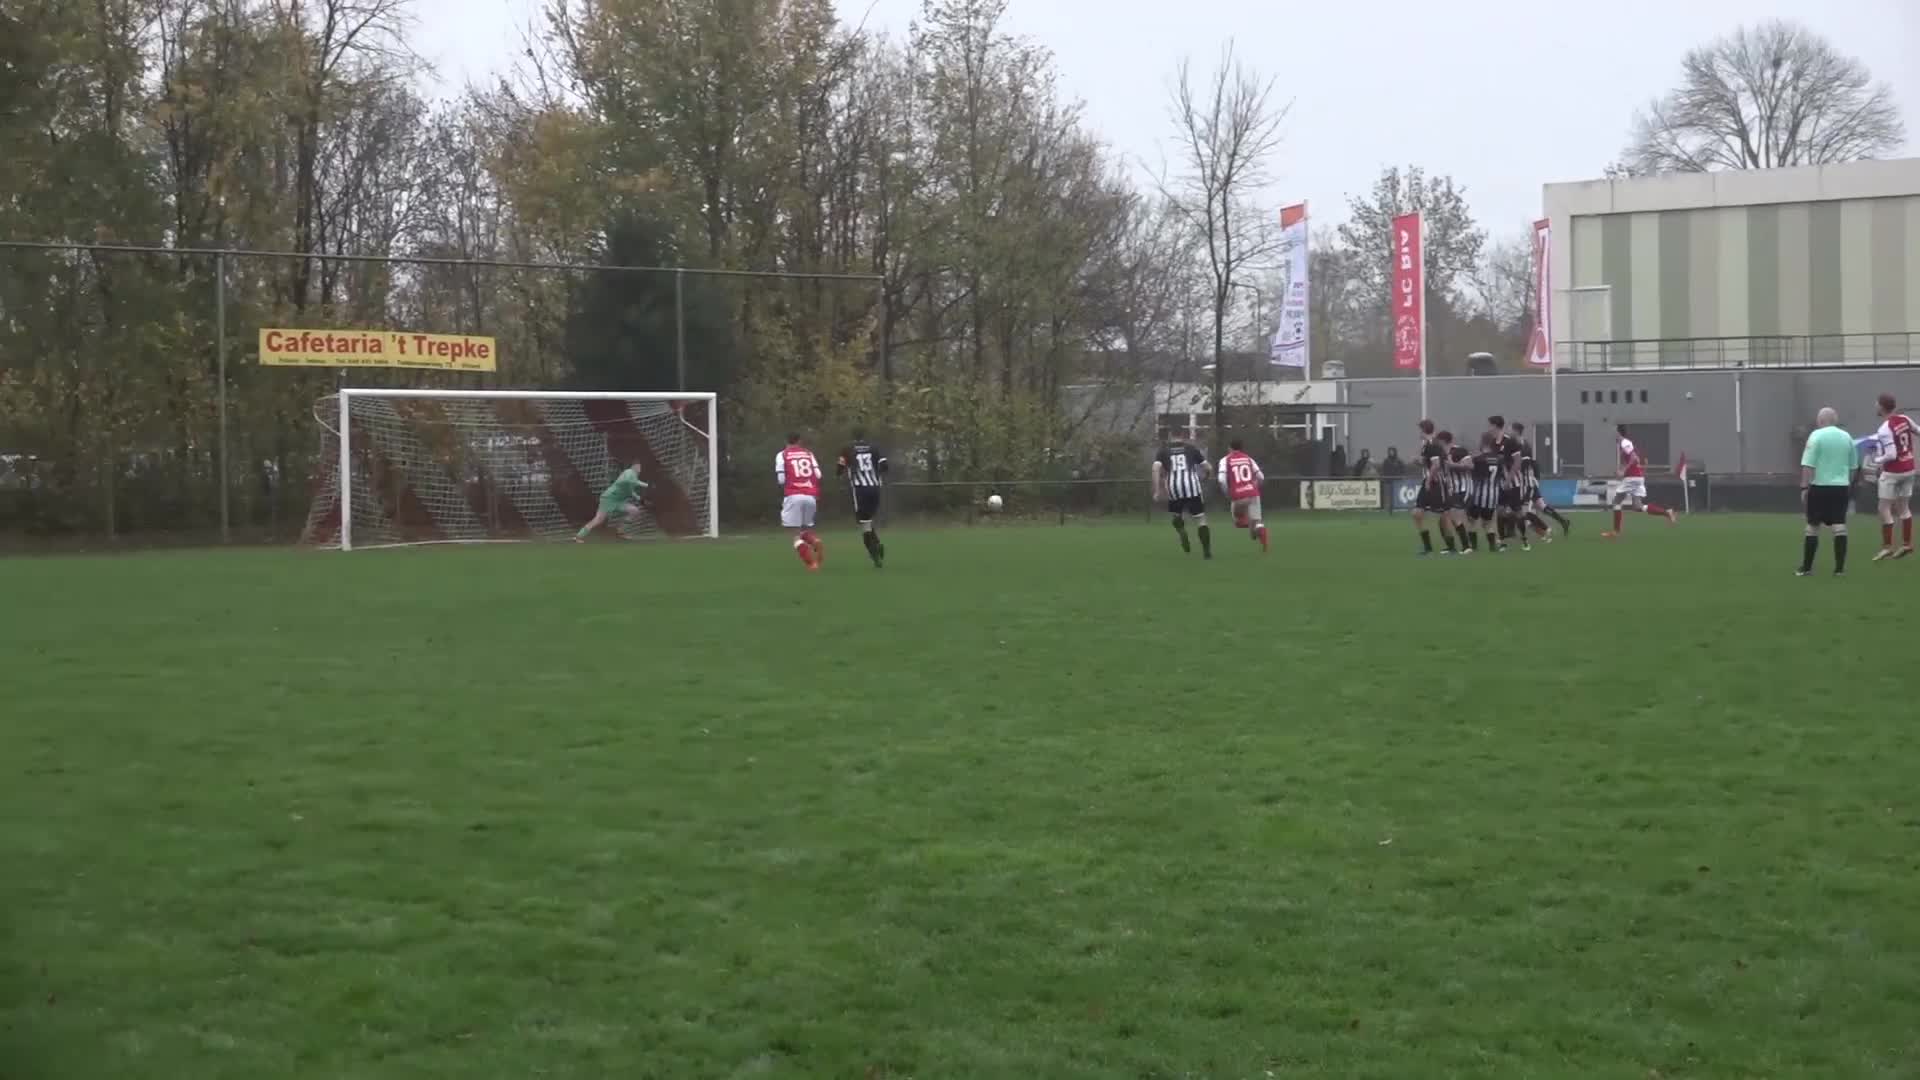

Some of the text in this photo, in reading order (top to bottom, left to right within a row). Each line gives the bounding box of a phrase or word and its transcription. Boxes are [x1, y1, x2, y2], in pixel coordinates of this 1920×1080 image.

[266, 330, 489, 362] Cafetaria 't Trepke
[790, 458, 813, 478] 18
[856, 452, 873, 471] 13
[1231, 464, 1252, 483] 10
[1488, 465, 1498, 484] 7
